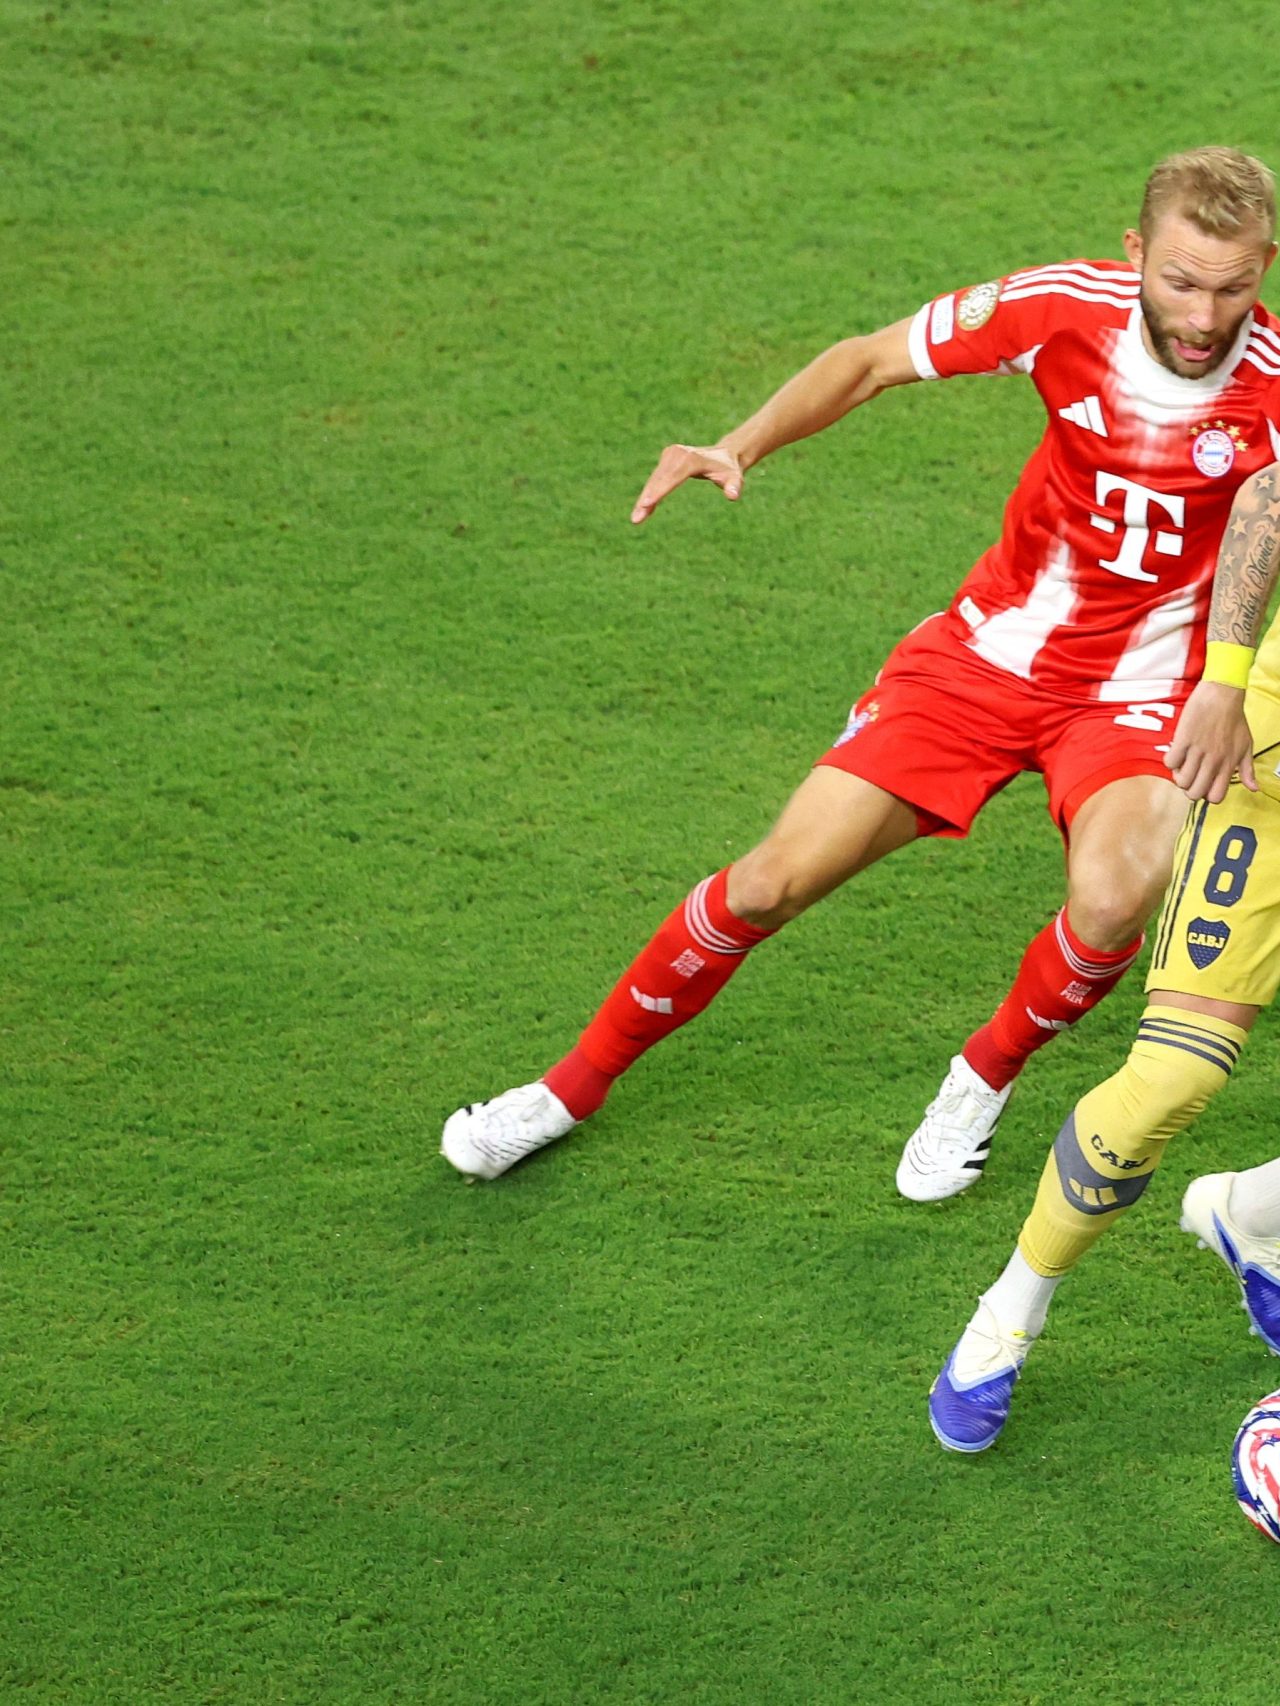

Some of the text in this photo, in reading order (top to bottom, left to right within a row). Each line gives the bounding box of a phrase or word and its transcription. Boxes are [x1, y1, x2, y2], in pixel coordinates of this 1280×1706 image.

[1090, 470, 1185, 583] T
[1203, 824, 1258, 908] 8
[1187, 931, 1226, 949] CABJ
